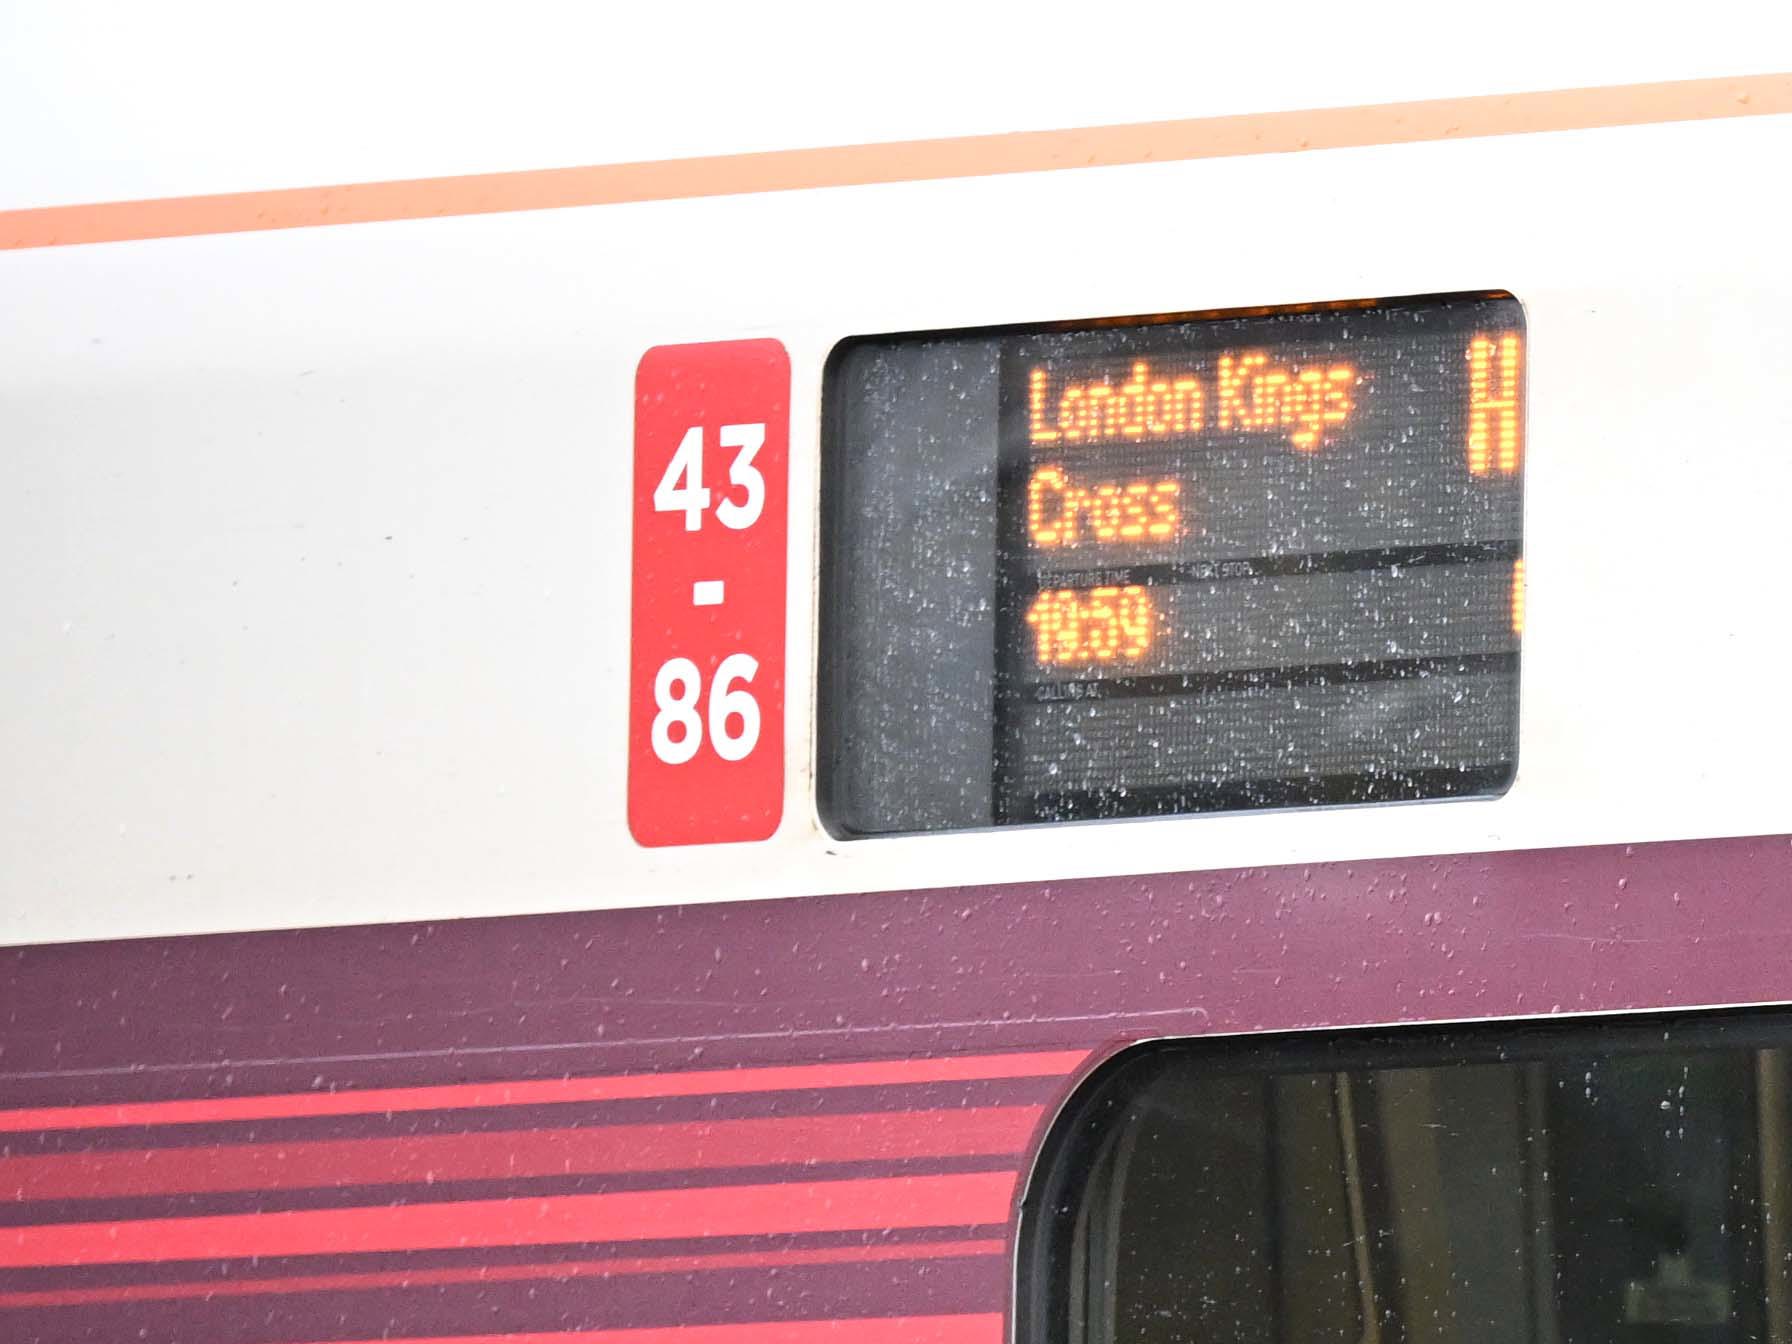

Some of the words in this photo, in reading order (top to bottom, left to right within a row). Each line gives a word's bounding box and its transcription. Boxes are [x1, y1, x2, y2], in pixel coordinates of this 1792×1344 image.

[1029, 360, 1204, 441] London
[1217, 349, 1355, 450] Kings
[653, 422, 767, 532] 43
[1028, 467, 1181, 545] Cross
[1222, 560, 1250, 577] STOP
[650, 652, 762, 765] 86
